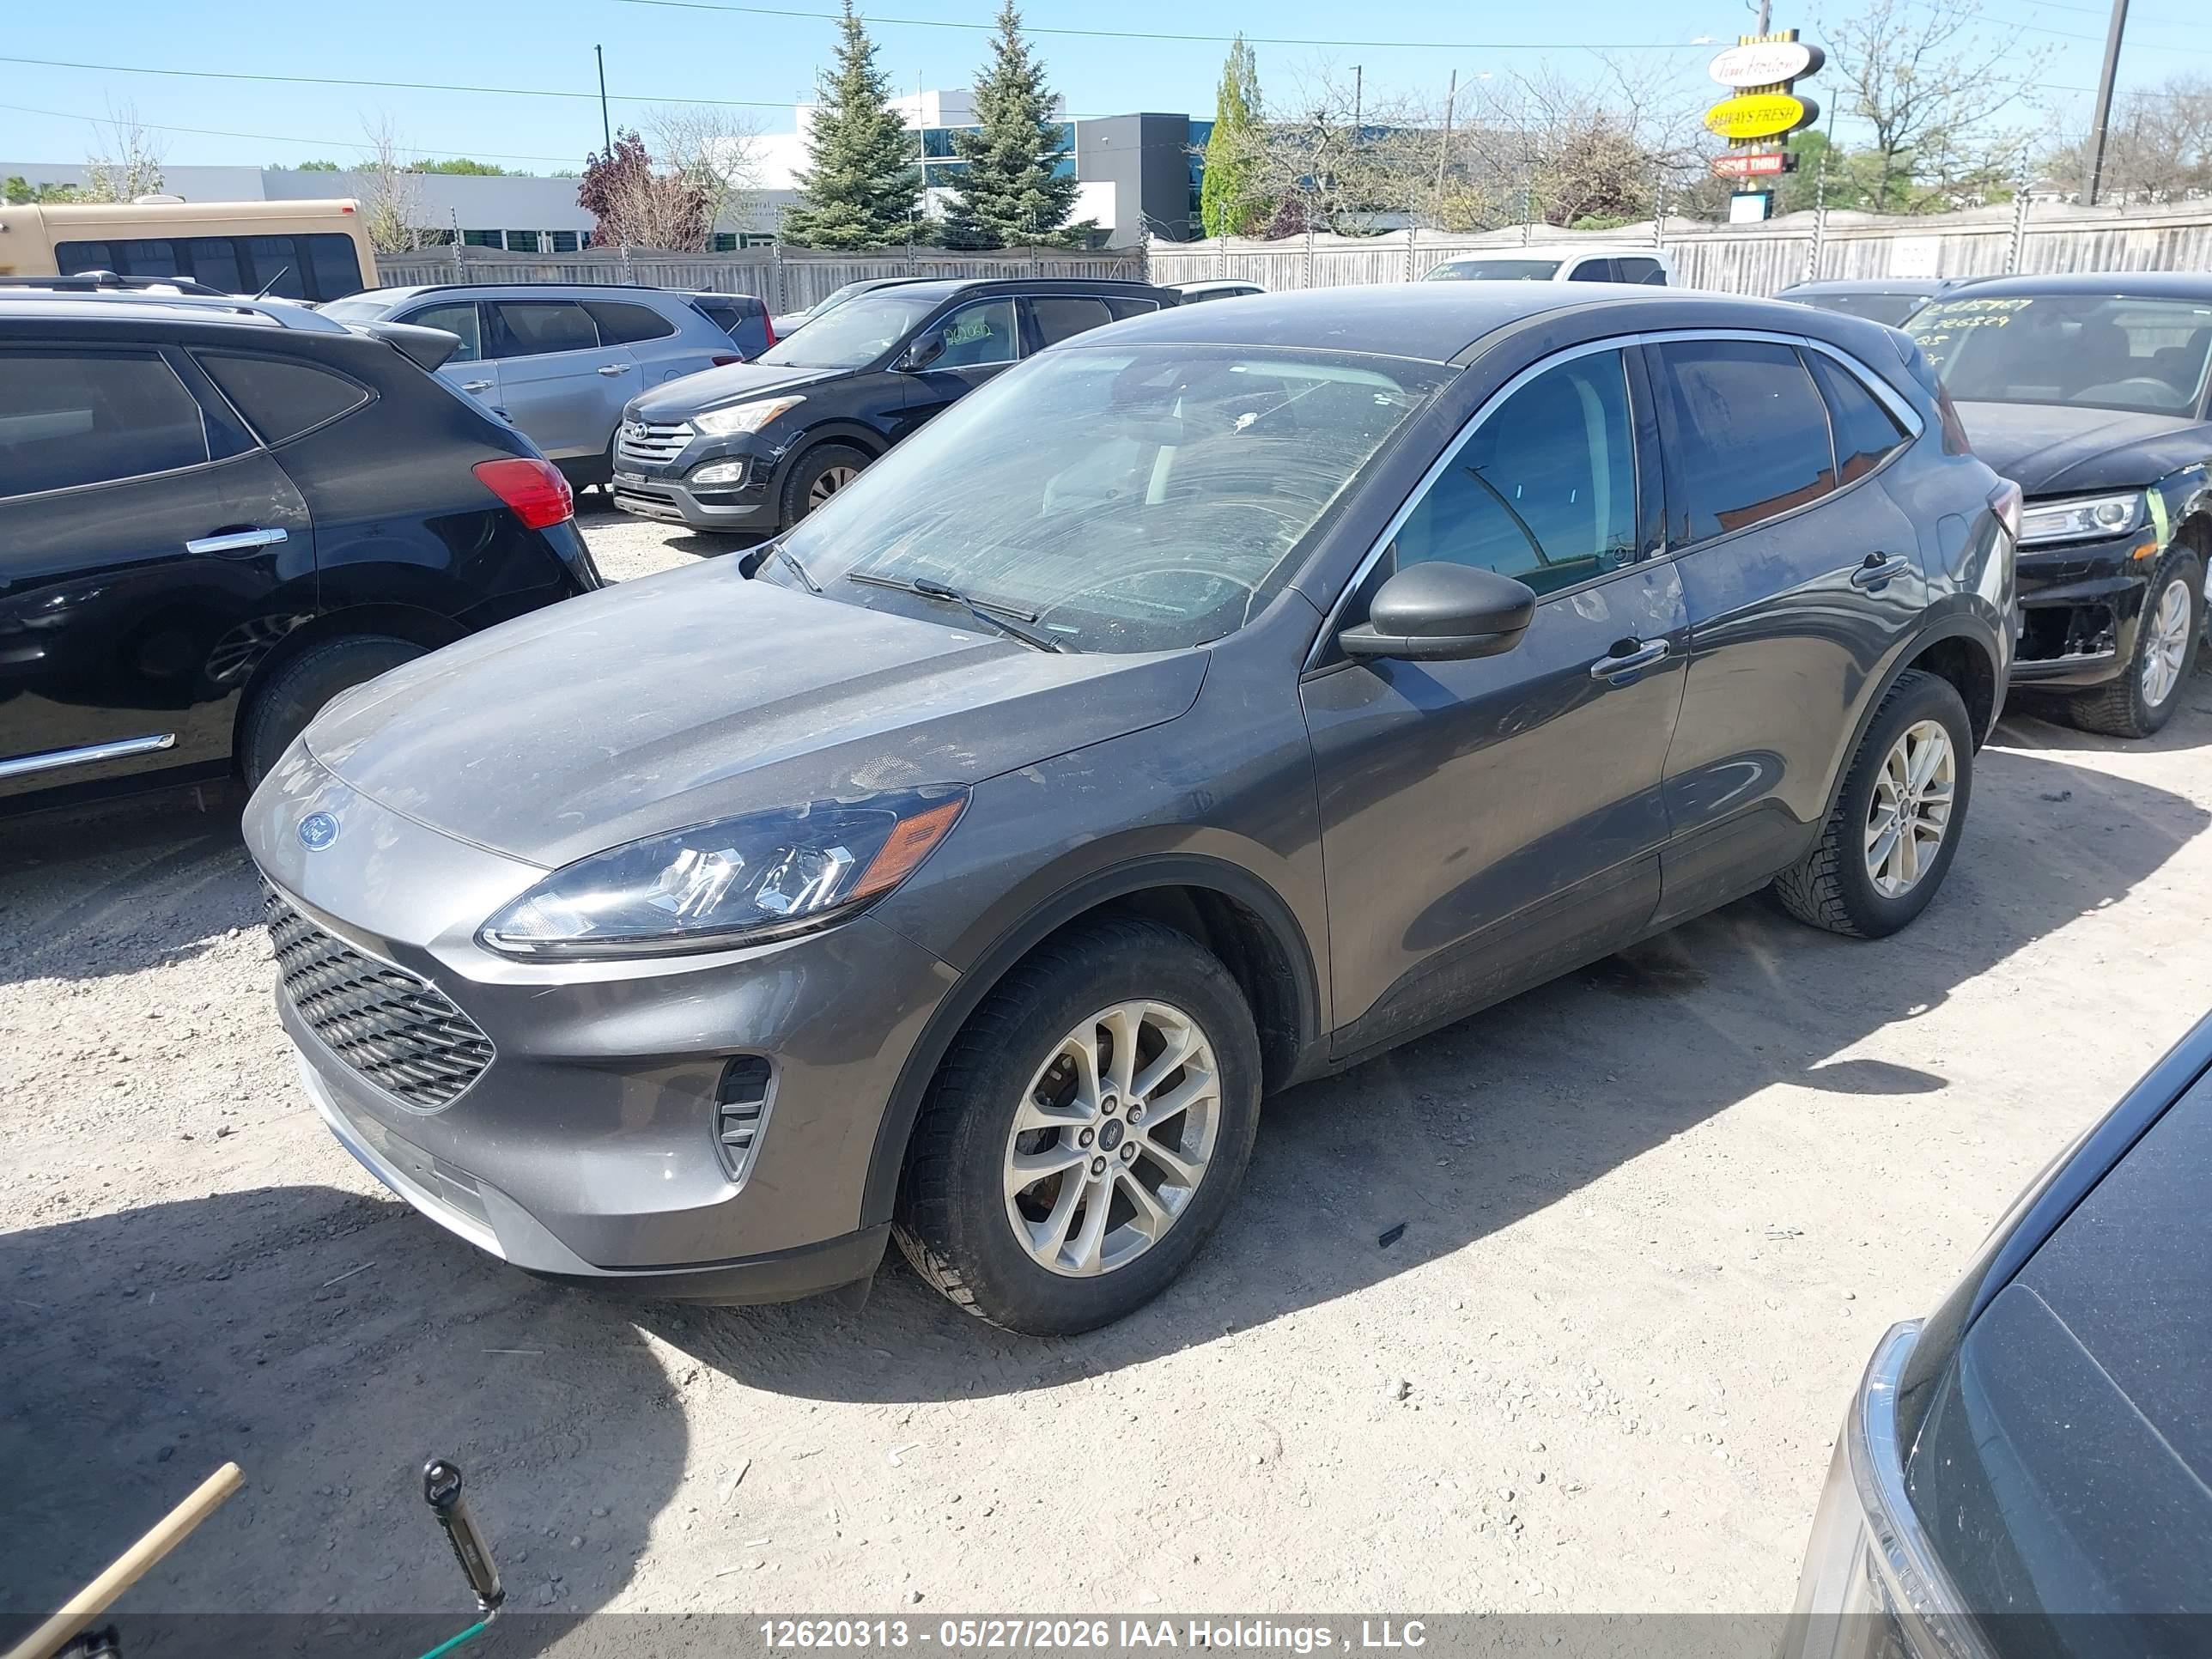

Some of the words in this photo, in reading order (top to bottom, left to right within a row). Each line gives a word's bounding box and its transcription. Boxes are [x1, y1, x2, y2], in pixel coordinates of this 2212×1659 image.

[1756, 106, 1796, 123] FRESH
[1750, 156, 1780, 171] THRU
[302, 817, 328, 842] Ford
